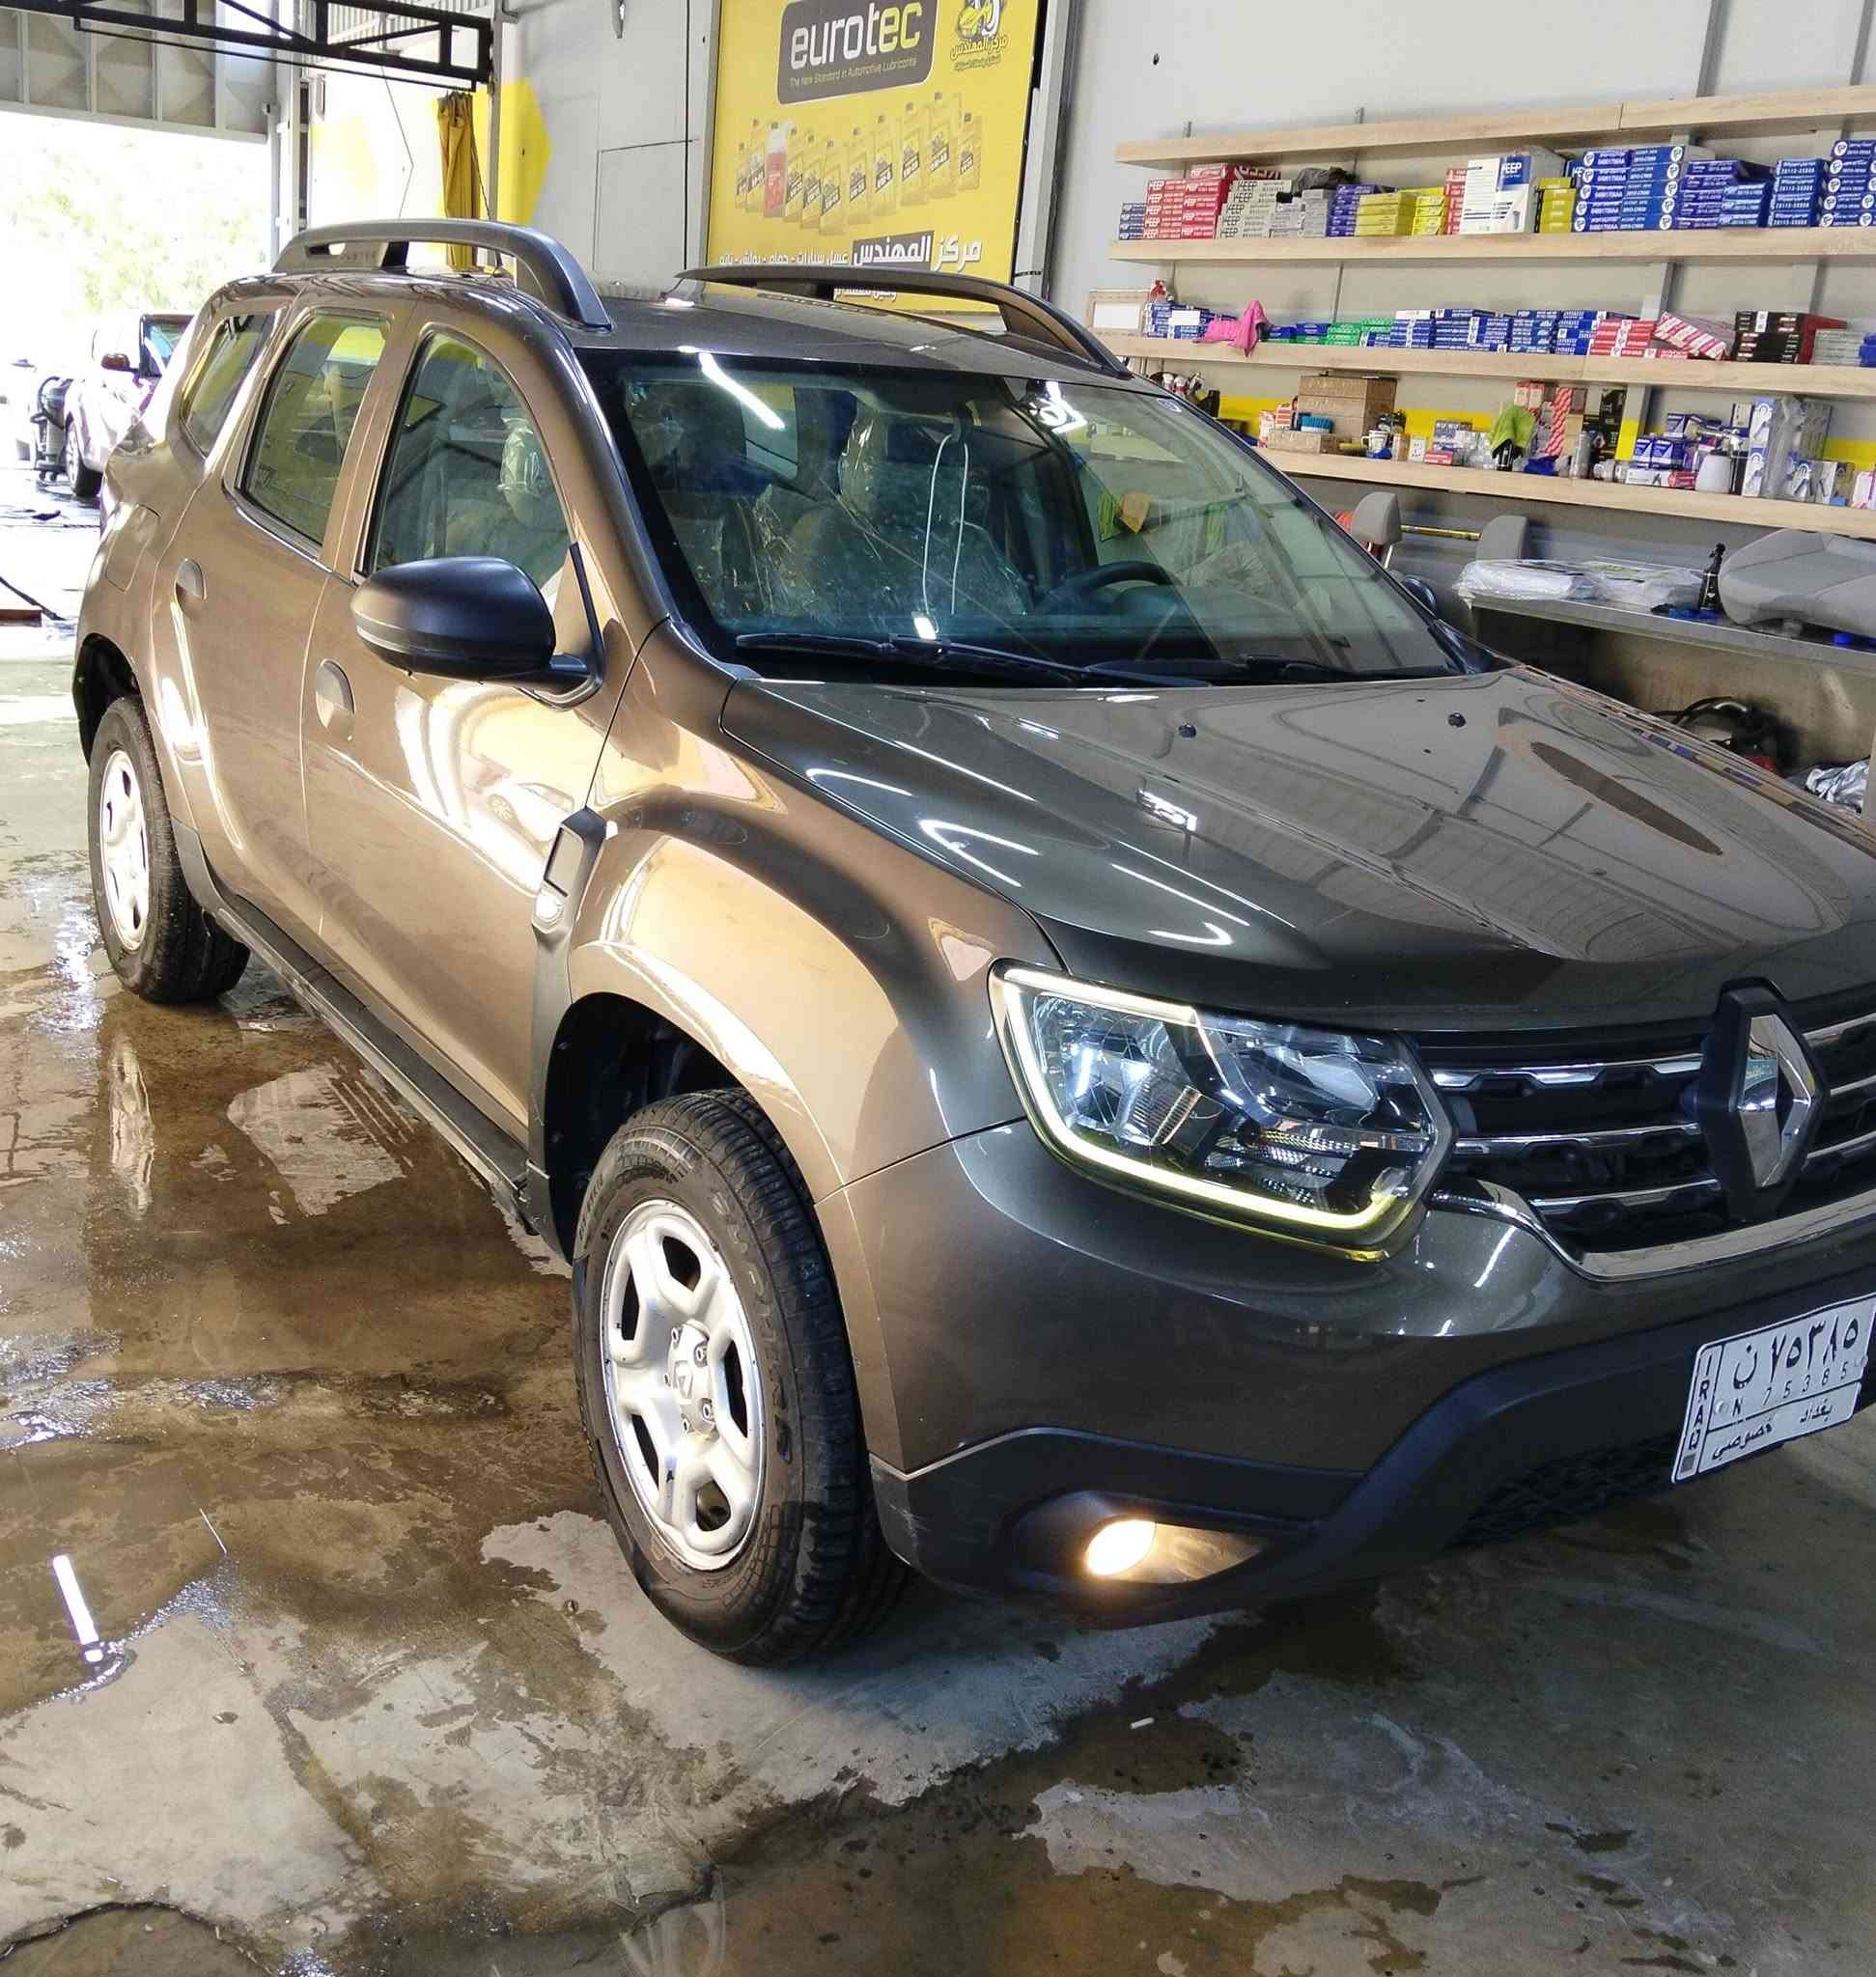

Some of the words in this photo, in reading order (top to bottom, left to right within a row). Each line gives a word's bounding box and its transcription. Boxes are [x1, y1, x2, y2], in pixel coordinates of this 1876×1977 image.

[790, 2, 922, 70] eurotec
[814, 70, 841, 84] Standard
[854, 236, 932, 266] المهندس
[935, 235, 983, 271] مركز
[1770, 1314, 1859, 1383] ٧٥٣٨٥
[1689, 1354, 1713, 1451] IRAQ
[1763, 1361, 1849, 1406] 75385
[1800, 1398, 1834, 1424] بغداد
[1712, 1418, 1773, 1461] خصوصي
